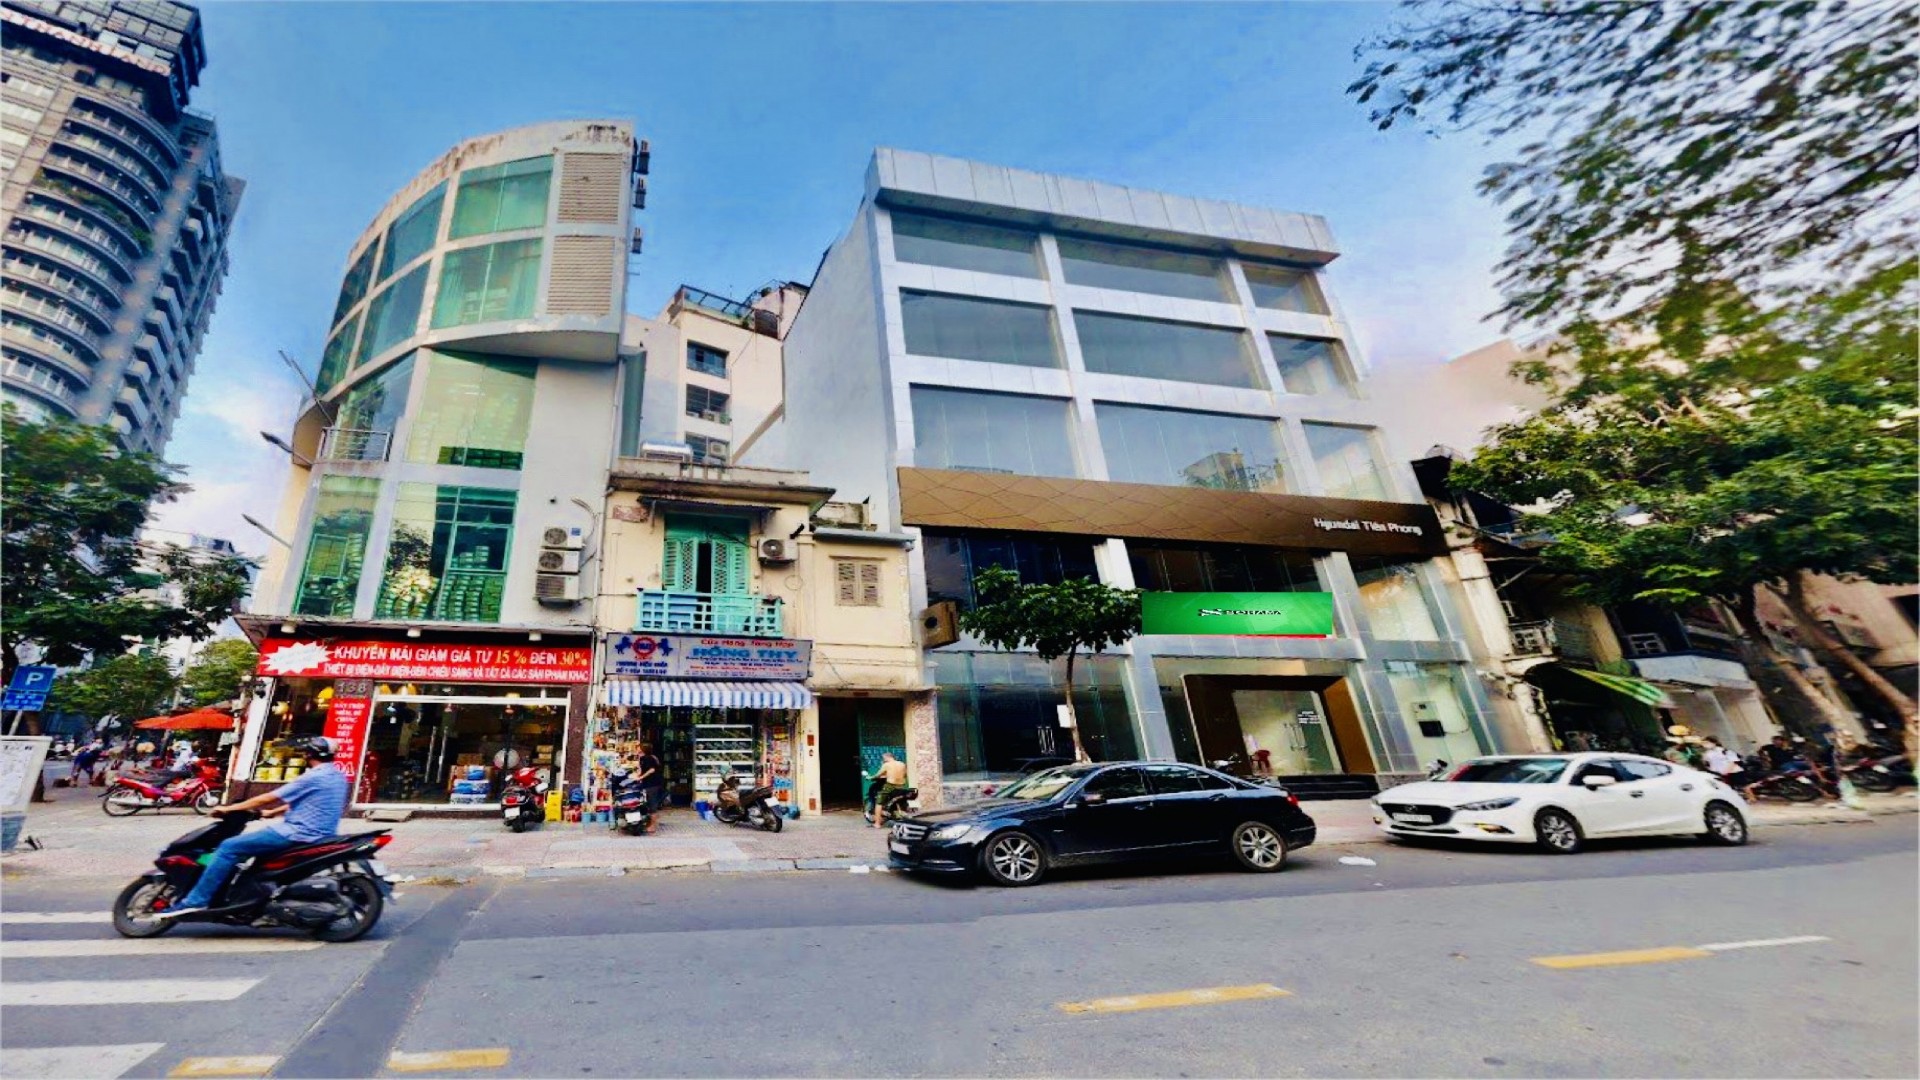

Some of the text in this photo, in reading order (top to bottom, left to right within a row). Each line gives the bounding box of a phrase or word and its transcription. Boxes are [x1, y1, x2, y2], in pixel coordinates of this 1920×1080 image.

[1387, 522, 1422, 536] Phong
[495, 650, 510, 664] 15
[559, 651, 588, 666] 30%
[25, 672, 44, 685] P
